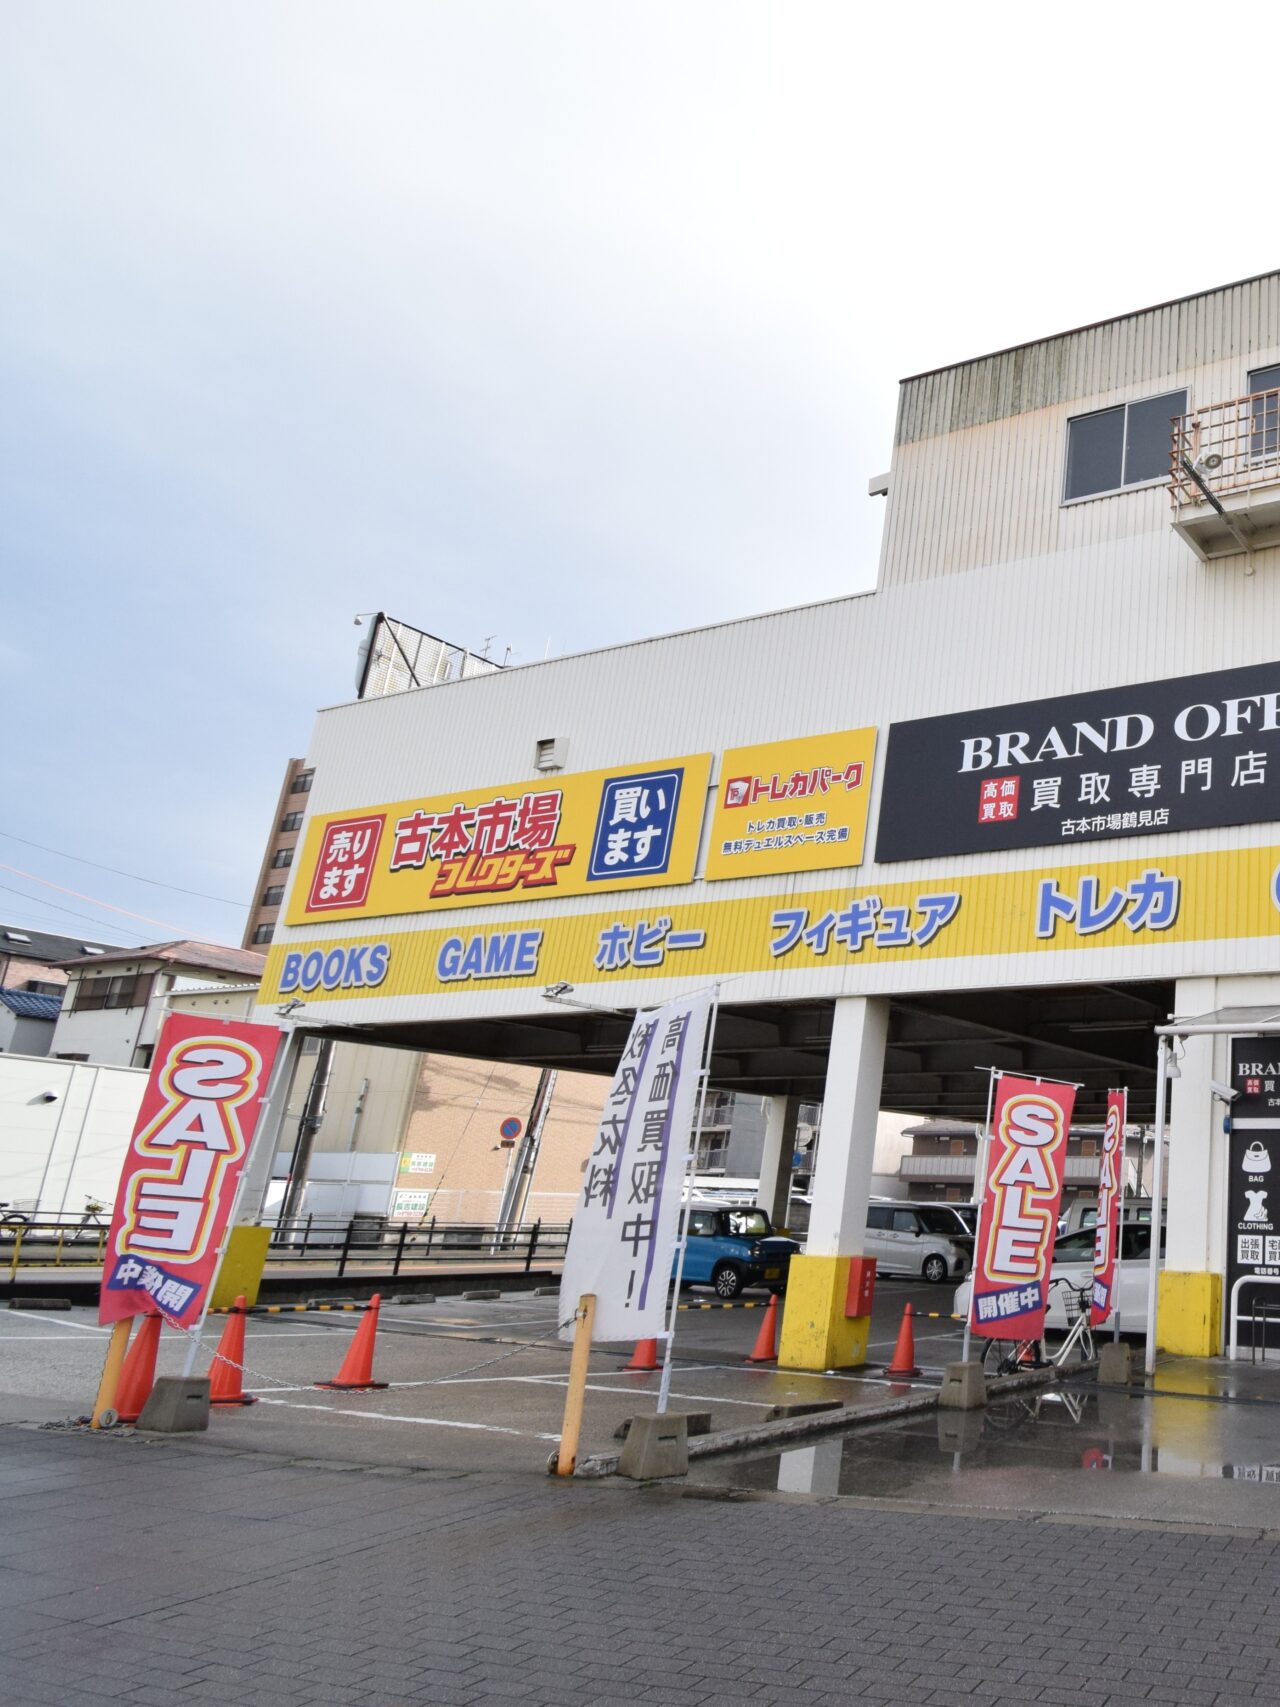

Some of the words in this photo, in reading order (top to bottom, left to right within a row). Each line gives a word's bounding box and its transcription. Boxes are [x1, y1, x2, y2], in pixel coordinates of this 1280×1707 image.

[957, 713, 1154, 774] BRAND
[751, 761, 865, 804] トレカパーク
[982, 778, 1017, 801] 高価
[1030, 752, 1268, 813] 買取専門店
[608, 786, 666, 826] 買い
[747, 812, 828, 834] トレカ買取・販売
[980, 801, 1016, 822] 買取
[1061, 808, 1170, 836] 古本市場鶴見店
[326, 822, 371, 862] 売り
[391, 791, 562, 871] 古本市場
[603, 825, 663, 866] ます
[721, 828, 850, 855] 無料デュエルスペース完備
[319, 866, 361, 900] ます
[432, 845, 575, 896] コレクターズ
[279, 944, 390, 992] BOOKS
[437, 929, 543, 982] GAME
[594, 916, 706, 970] ホビー
[769, 892, 961, 957] フィギュア
[1035, 868, 1182, 939] トレカ
[993, 1104, 1055, 1274] SALE
[1248, 1175, 1265, 1183] BAG
[1237, 1222, 1274, 1231] CLOTHING
[1240, 1238, 1260, 1250] 出張
[1240, 1249, 1260, 1261] 買取
[976, 1286, 1041, 1321] 開催中
